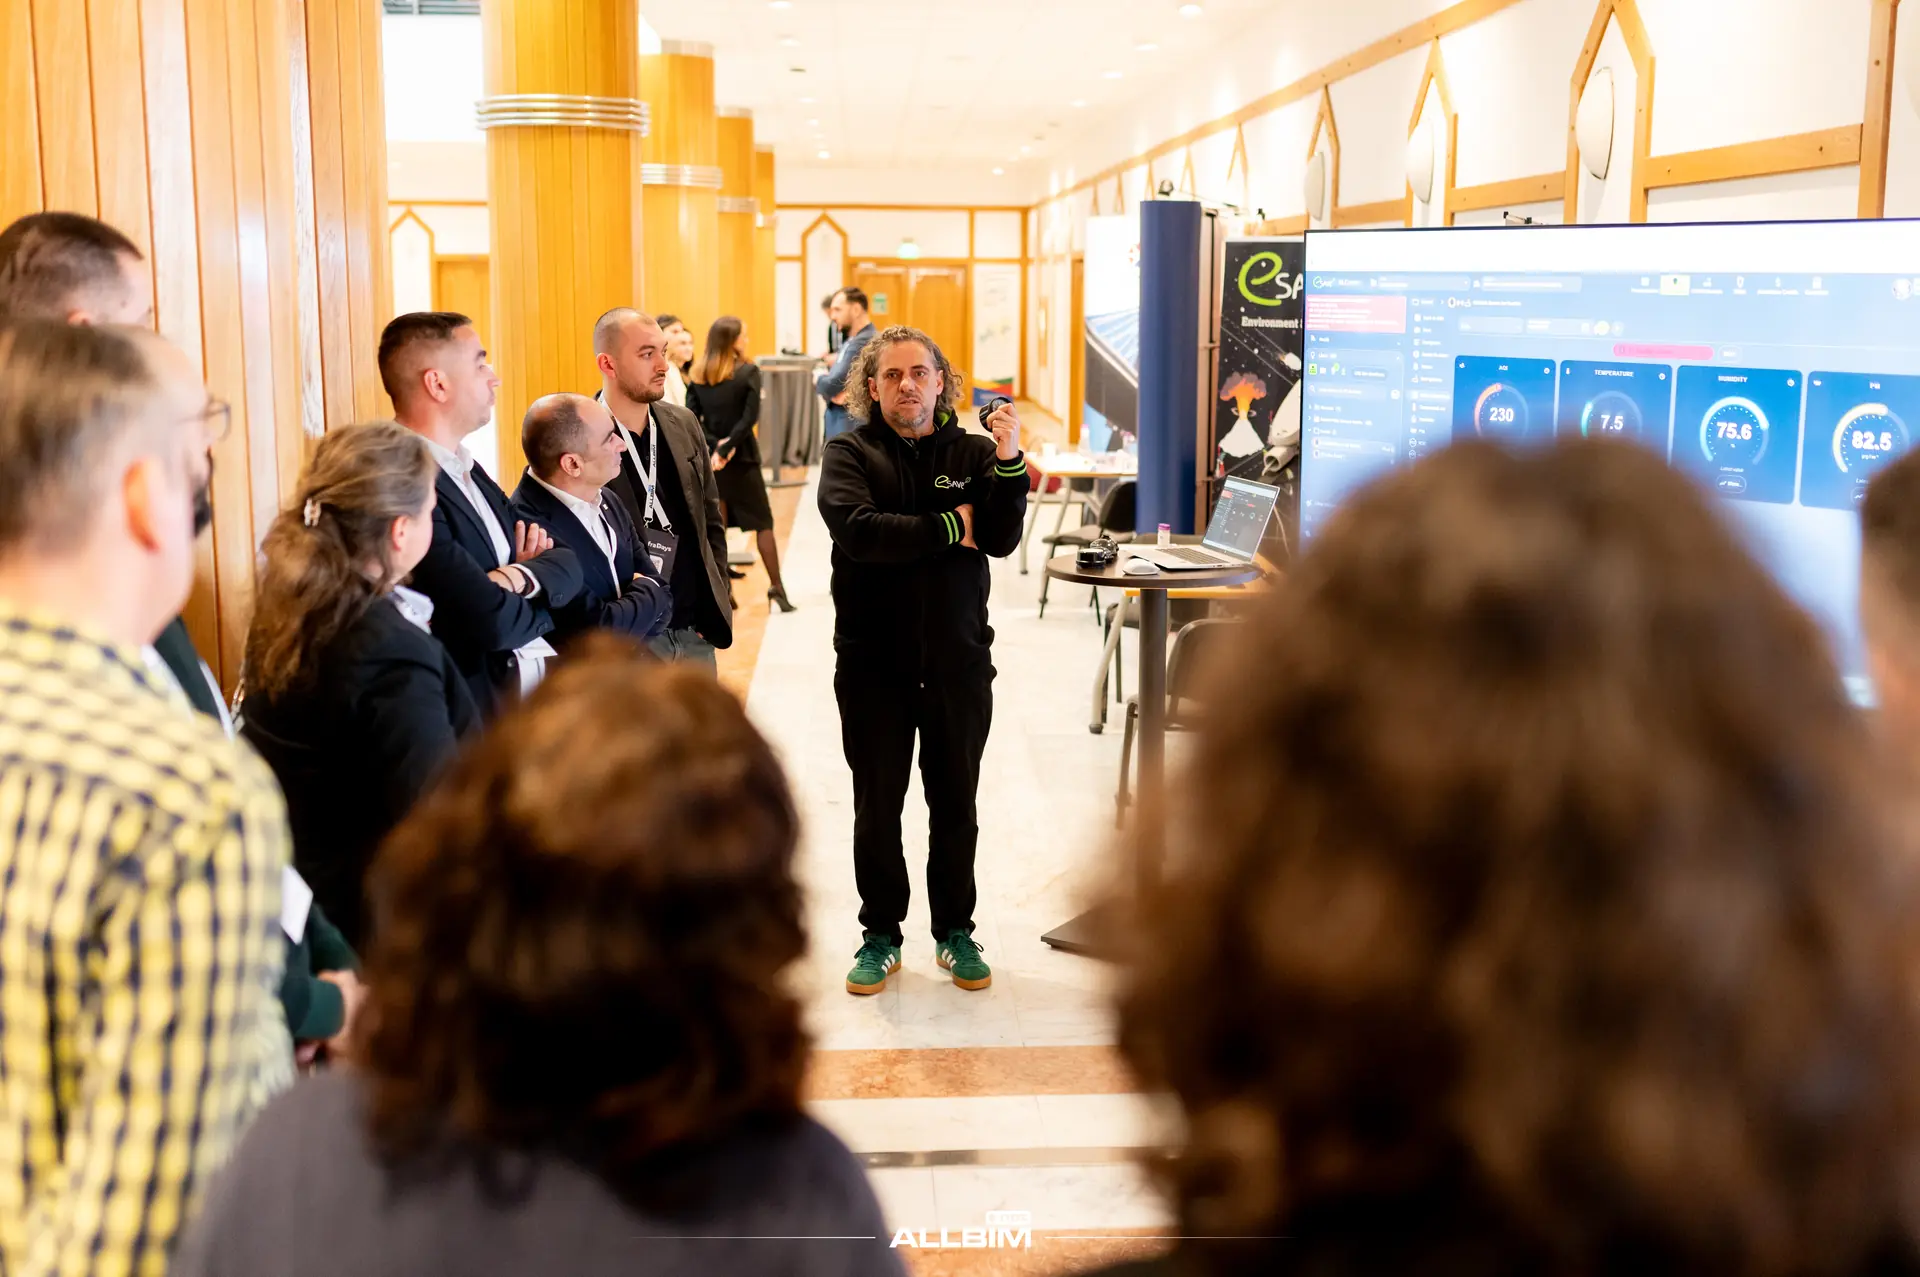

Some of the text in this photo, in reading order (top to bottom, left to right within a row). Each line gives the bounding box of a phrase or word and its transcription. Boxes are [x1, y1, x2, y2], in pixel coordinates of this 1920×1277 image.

[1238, 251, 1303, 306] eSA
[1241, 316, 1299, 328] Environment
[1594, 369, 1635, 377] TEMPERATURE
[1718, 375, 1748, 383] HUMIDITY
[1489, 407, 1514, 422] 230
[1601, 414, 1624, 430] 7.5
[1716, 421, 1752, 440] 75.6
[1852, 430, 1892, 451] 82.5
[647, 541, 672, 552] fraDays
